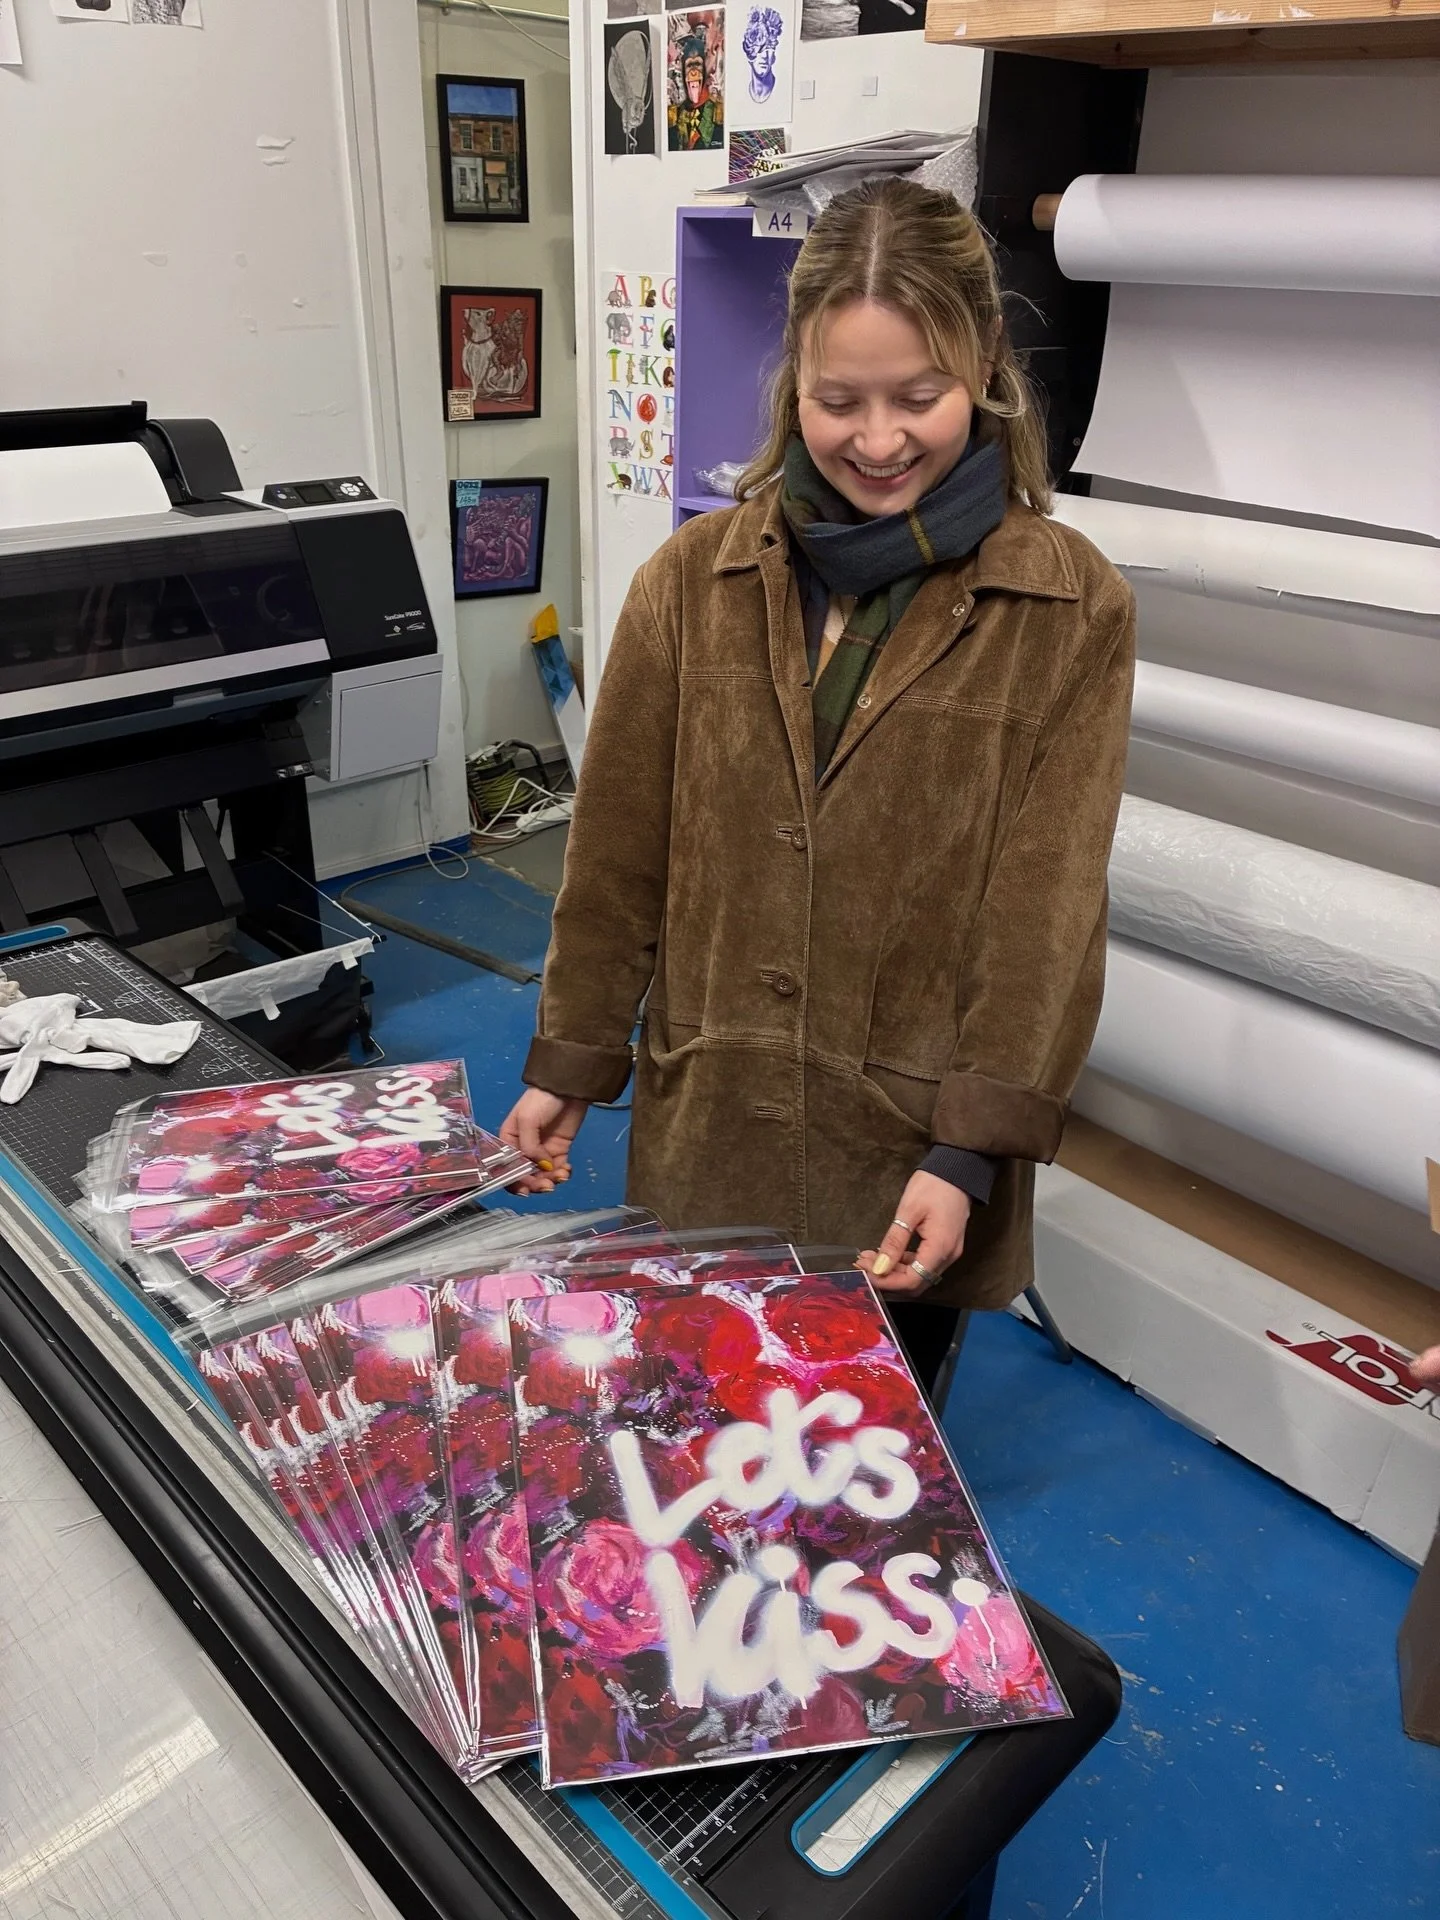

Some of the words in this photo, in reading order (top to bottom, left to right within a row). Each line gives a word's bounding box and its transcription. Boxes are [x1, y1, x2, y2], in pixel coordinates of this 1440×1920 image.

[768, 212, 793, 232] A4
[641, 355, 662, 387] K
[608, 389, 633, 421] N
